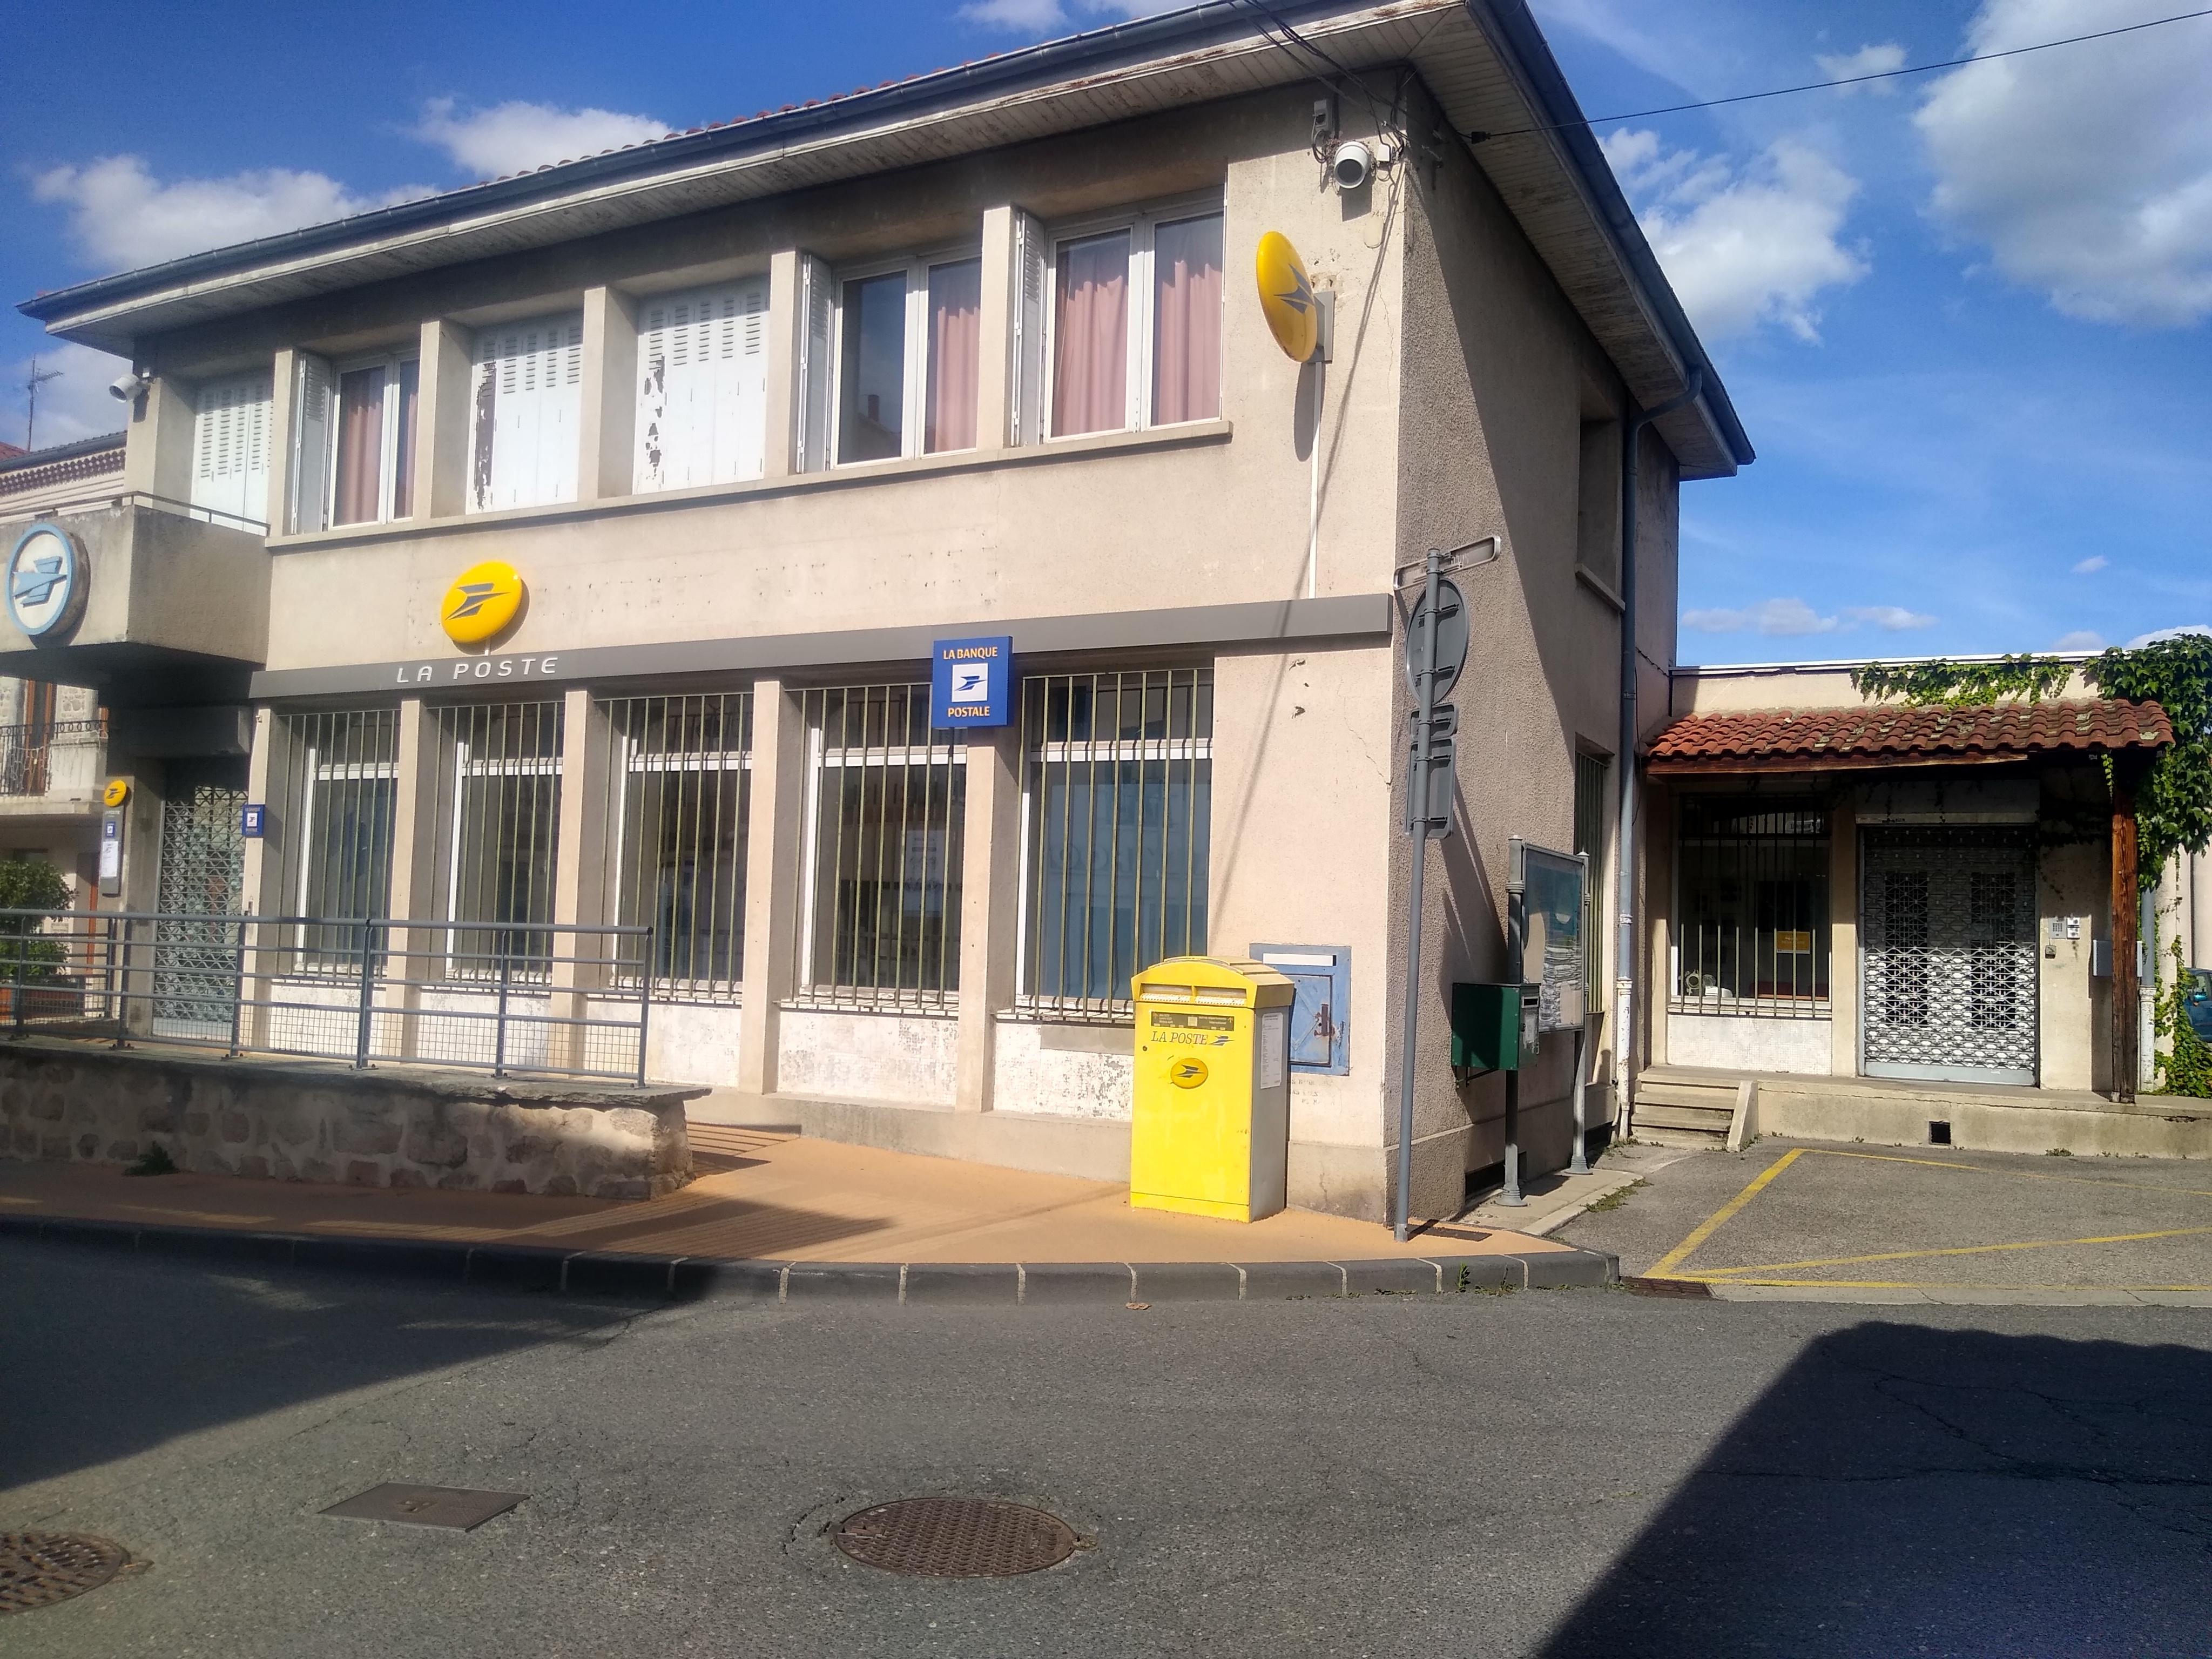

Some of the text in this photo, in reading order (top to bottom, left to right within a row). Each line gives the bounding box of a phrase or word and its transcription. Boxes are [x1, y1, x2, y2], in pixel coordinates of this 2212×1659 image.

[943, 646, 998, 659] LA BANQUE
[396, 657, 558, 683] LA POSTE
[948, 706, 990, 717] POSTALE
[1150, 1031, 1209, 1045] LA POSTE
